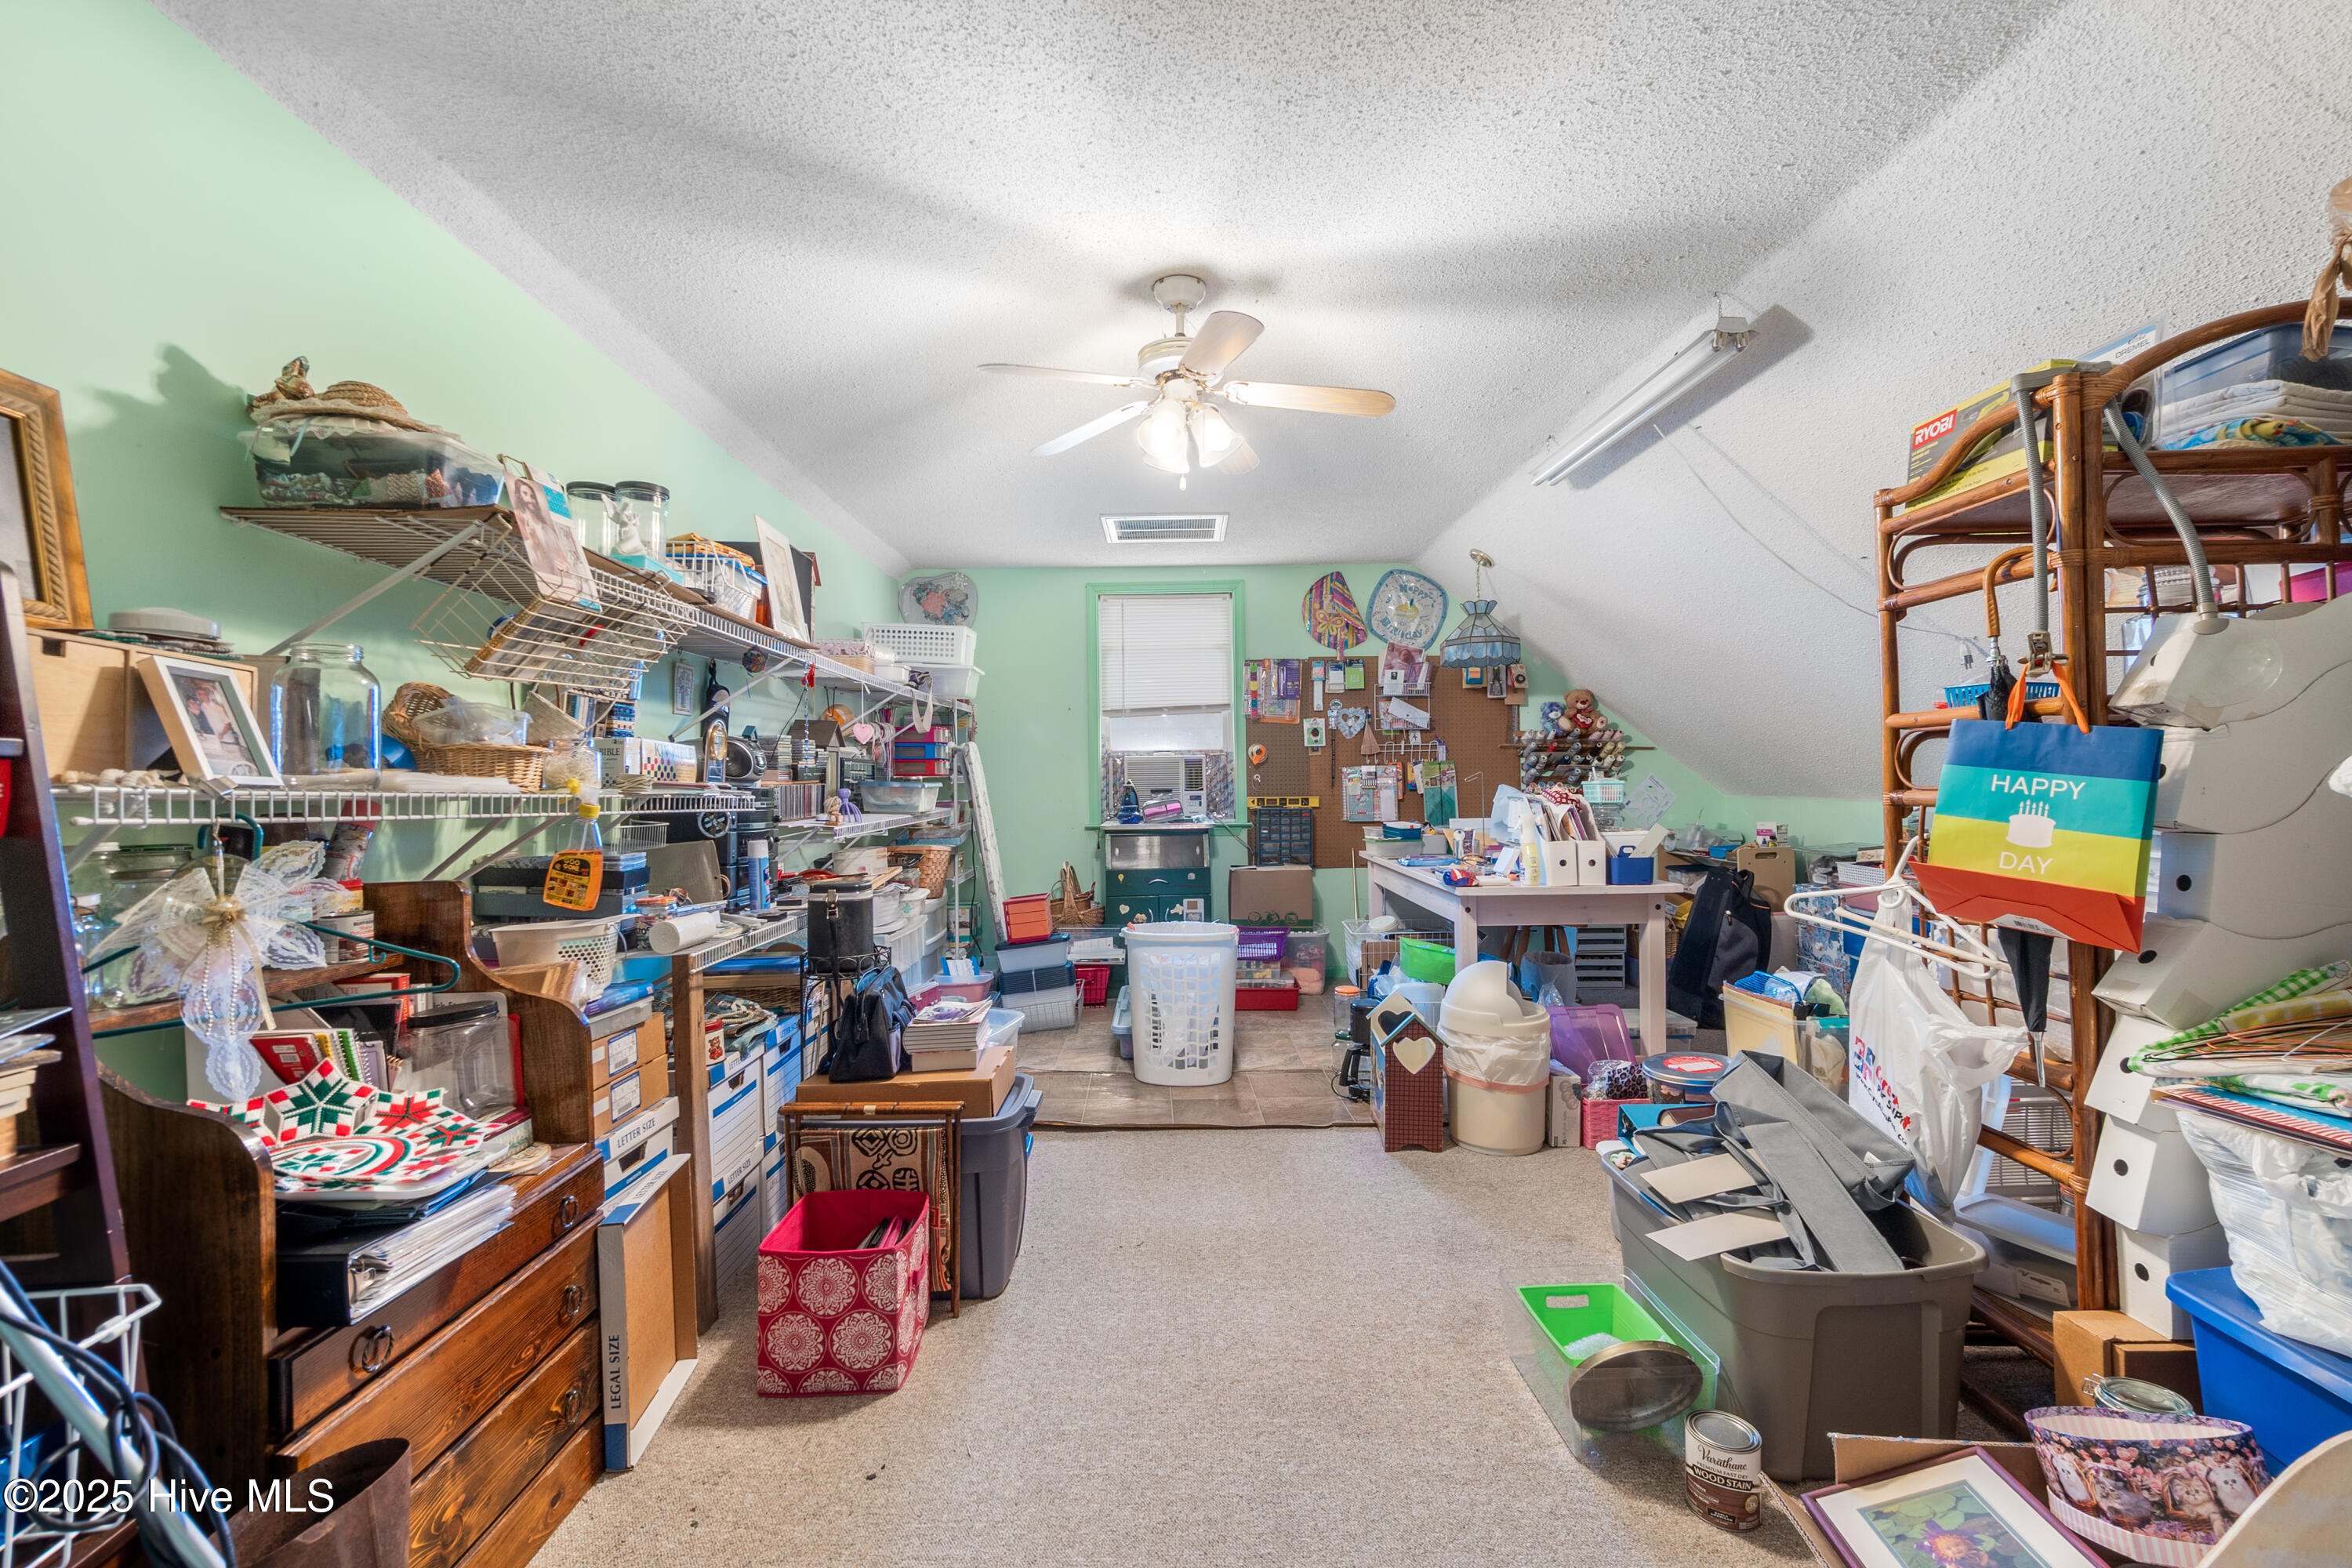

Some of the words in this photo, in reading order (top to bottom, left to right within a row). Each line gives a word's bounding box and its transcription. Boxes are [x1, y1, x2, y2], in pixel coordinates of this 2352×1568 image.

[2115, 339, 2151, 358] DREMEL
[1915, 414, 1954, 445] RYOBI
[1991, 774, 2086, 800] HAPPY
[1998, 851, 2053, 875] DAY
[617, 1127, 641, 1148] LETTER
[643, 1117, 655, 1133] SIZE
[728, 1167, 743, 1185] LETTER
[742, 1158, 751, 1171] SIZE
[633, 1181, 656, 1200] LETTER
[608, 1335, 620, 1363] SIZE
[610, 1367, 621, 1409] LEGAL
[1697, 1445, 1748, 1472] Varathane
[1697, 1461, 1722, 1474] PREMIUM
[1693, 1465, 1725, 1484] WOOD
[1726, 1479, 1751, 1490] STAIN
